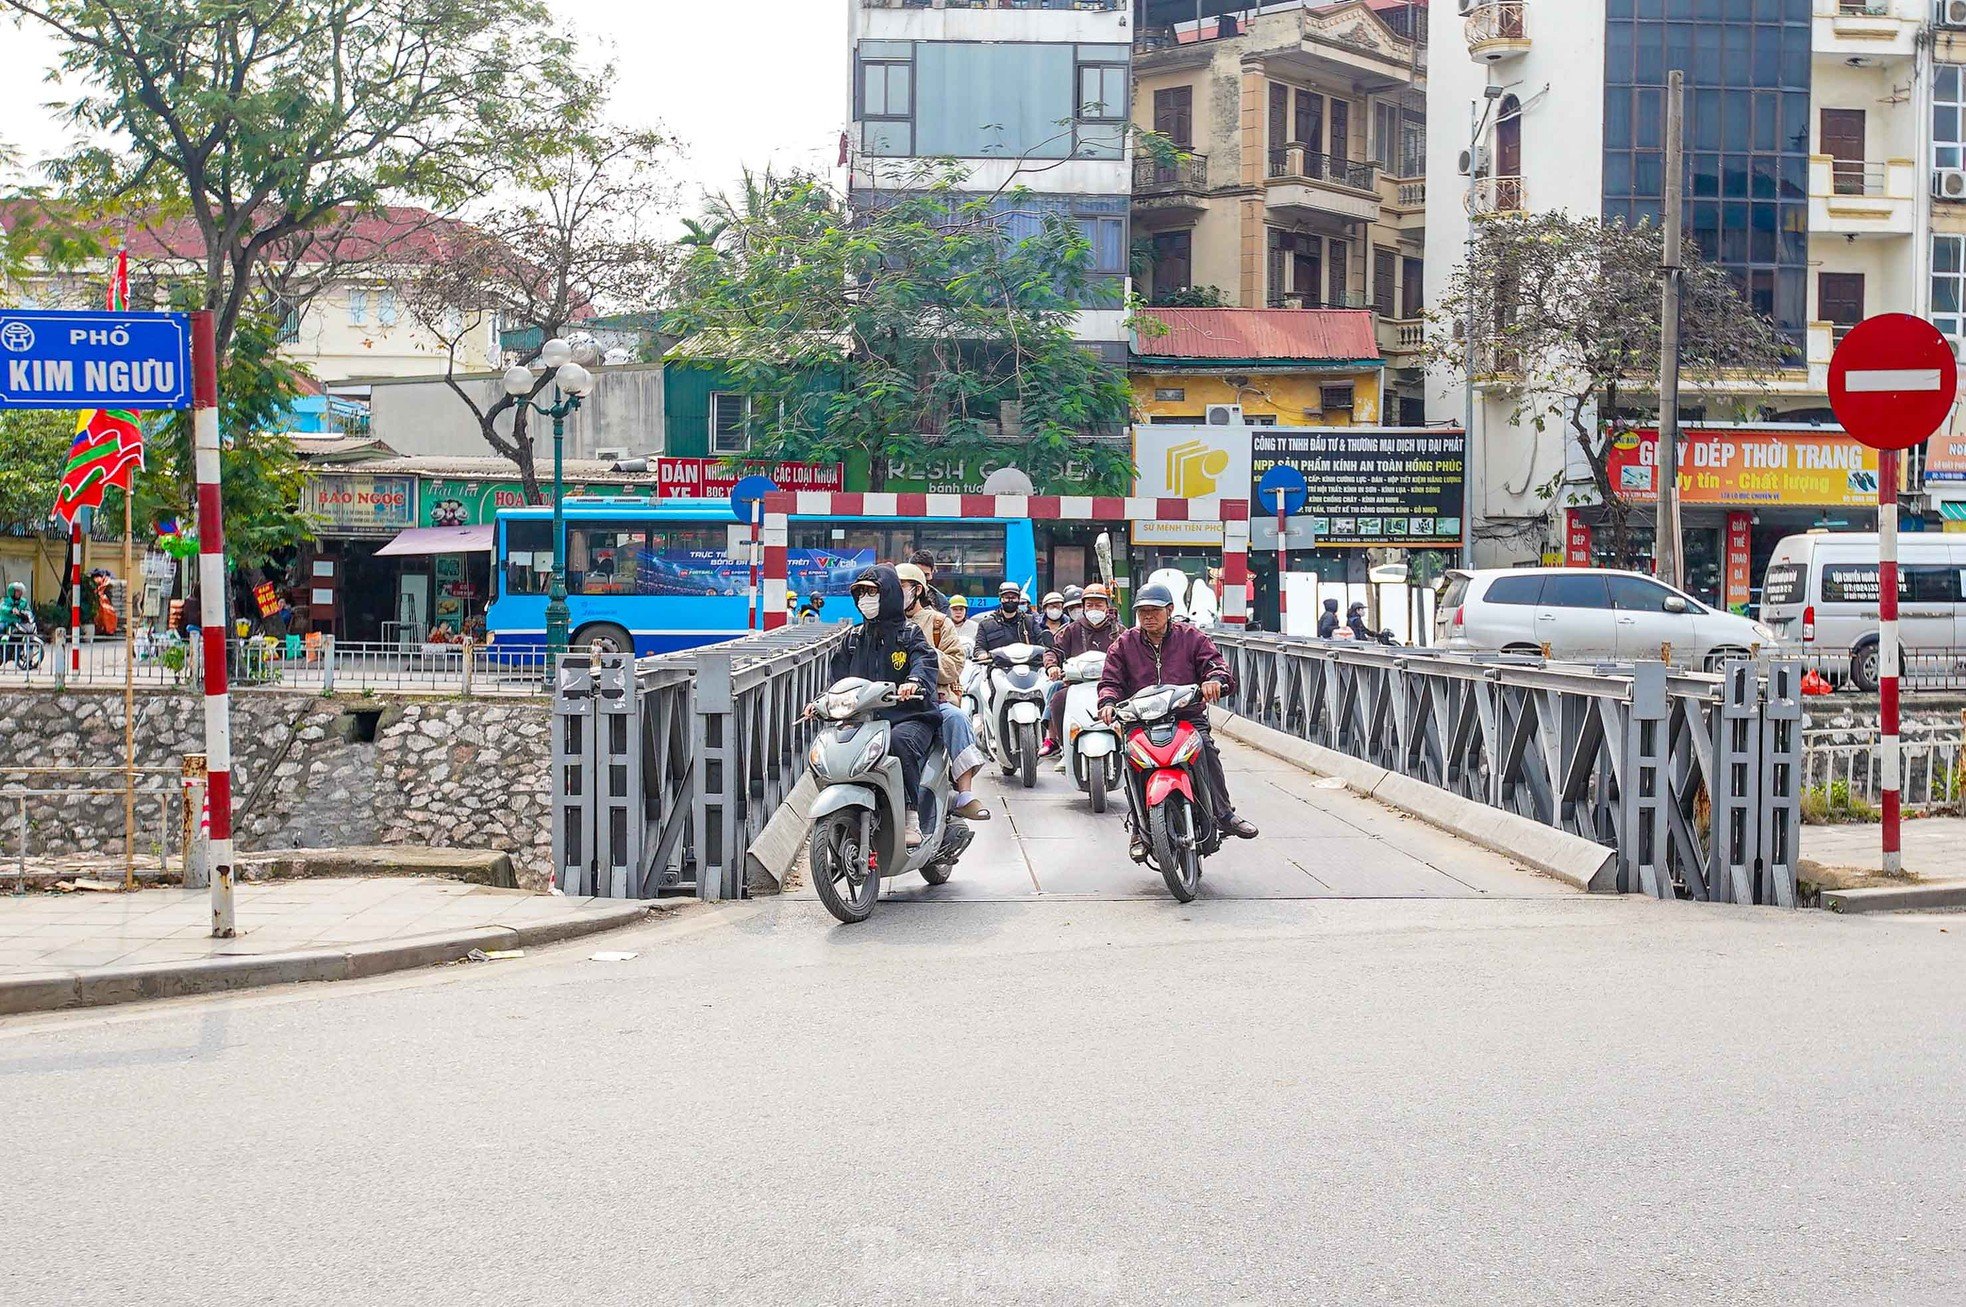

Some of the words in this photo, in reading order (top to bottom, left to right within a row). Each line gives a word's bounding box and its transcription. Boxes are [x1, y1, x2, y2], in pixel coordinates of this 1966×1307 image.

[69, 323, 131, 346] PHỐ
[9, 359, 73, 392] KIM
[85, 358, 175, 393] NGƯU
[1254, 435, 1276, 451] CÔNG
[1278, 438, 1286, 451] TY
[1288, 439, 1308, 452] TNHH
[1328, 437, 1338, 452] TƯ
[1339, 440, 1346, 452] &
[1380, 439, 1395, 455] MẠI
[1396, 439, 1415, 455] DỊCH
[1416, 439, 1427, 455] VỤ
[1443, 436, 1463, 453] PHÁT
[1640, 440, 1688, 466] GIY
[1694, 437, 1735, 468] DÉP
[1742, 438, 1788, 469] THỜI
[1795, 444, 1863, 470] TRANG
[661, 461, 698, 483] DÁN
[774, 463, 791, 483] CÁC
[1333, 458, 1358, 472] KÍNH
[1360, 461, 1374, 472] AN
[1376, 458, 1403, 472] TOÀN
[929, 483, 959, 493] bánh
[1697, 472, 1719, 489] tín
[1739, 472, 1778, 490] Chất
[1783, 472, 1830, 494] lượng
[495, 491, 525, 506] HOA
